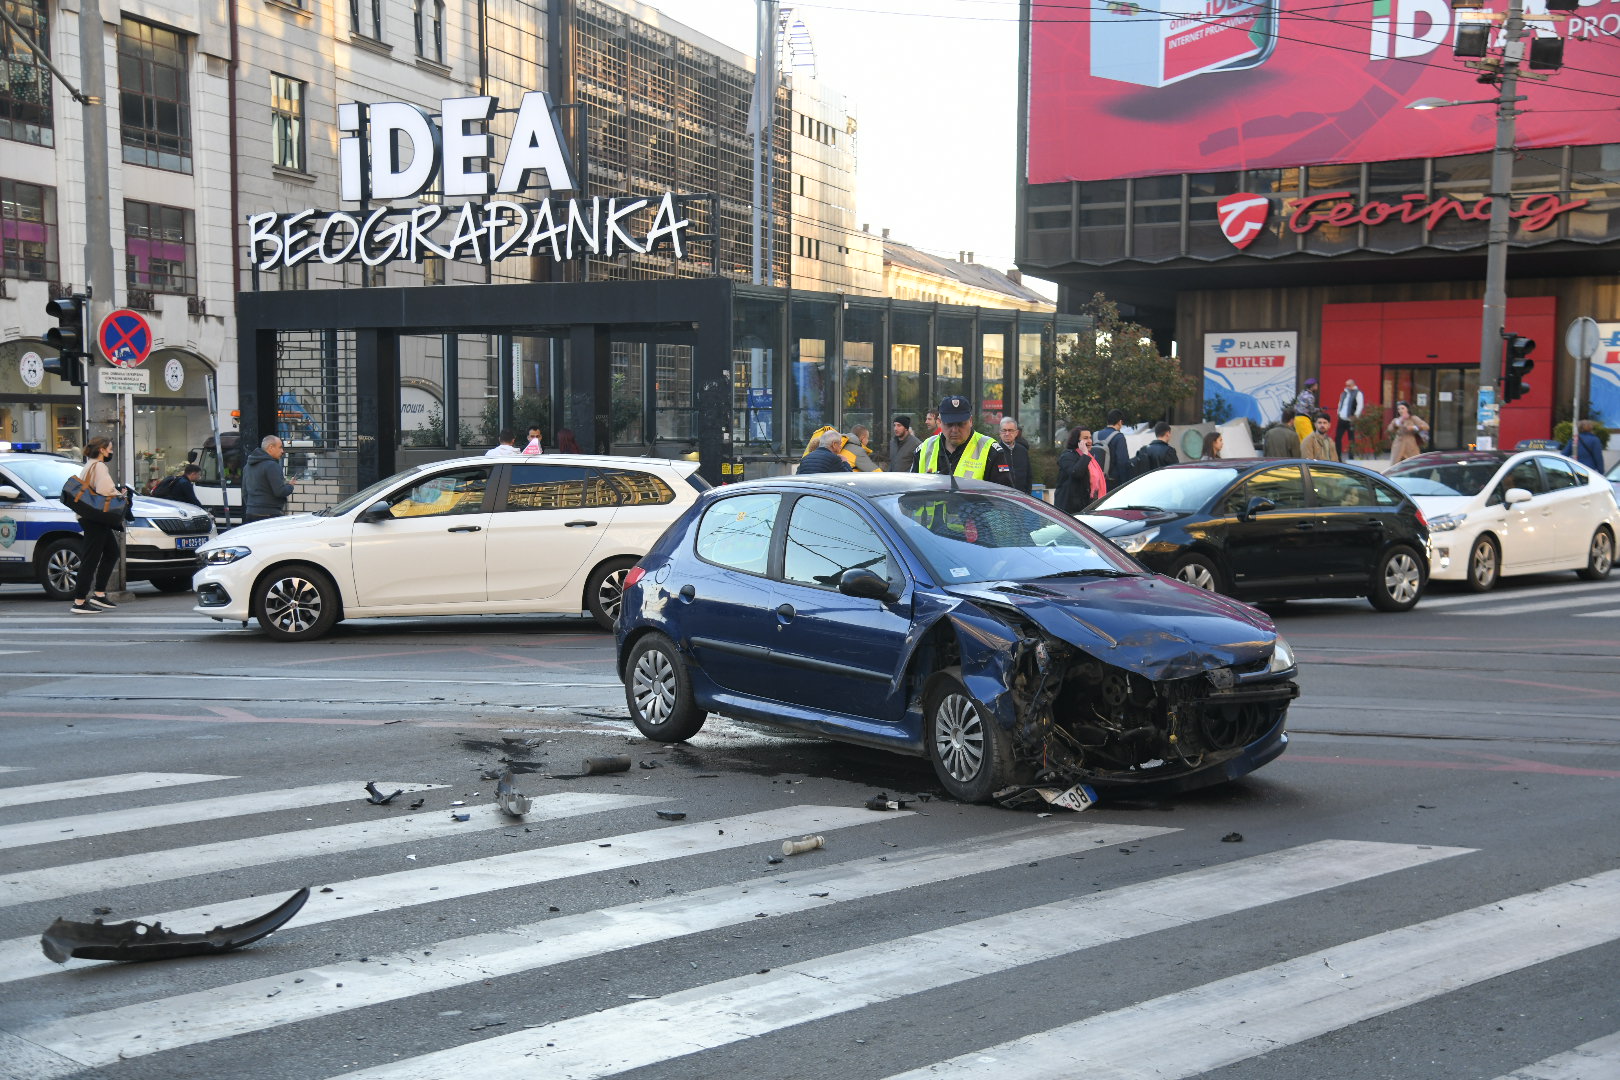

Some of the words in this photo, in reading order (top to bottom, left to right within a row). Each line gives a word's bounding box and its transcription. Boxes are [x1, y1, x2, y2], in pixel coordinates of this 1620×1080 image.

[1168, 29, 1205, 50] INTERNET
[248, 192, 690, 270] BEOGRAĐANKA
[1239, 340, 1291, 350] PLANETA
[1225, 356, 1275, 368] OUTLET
